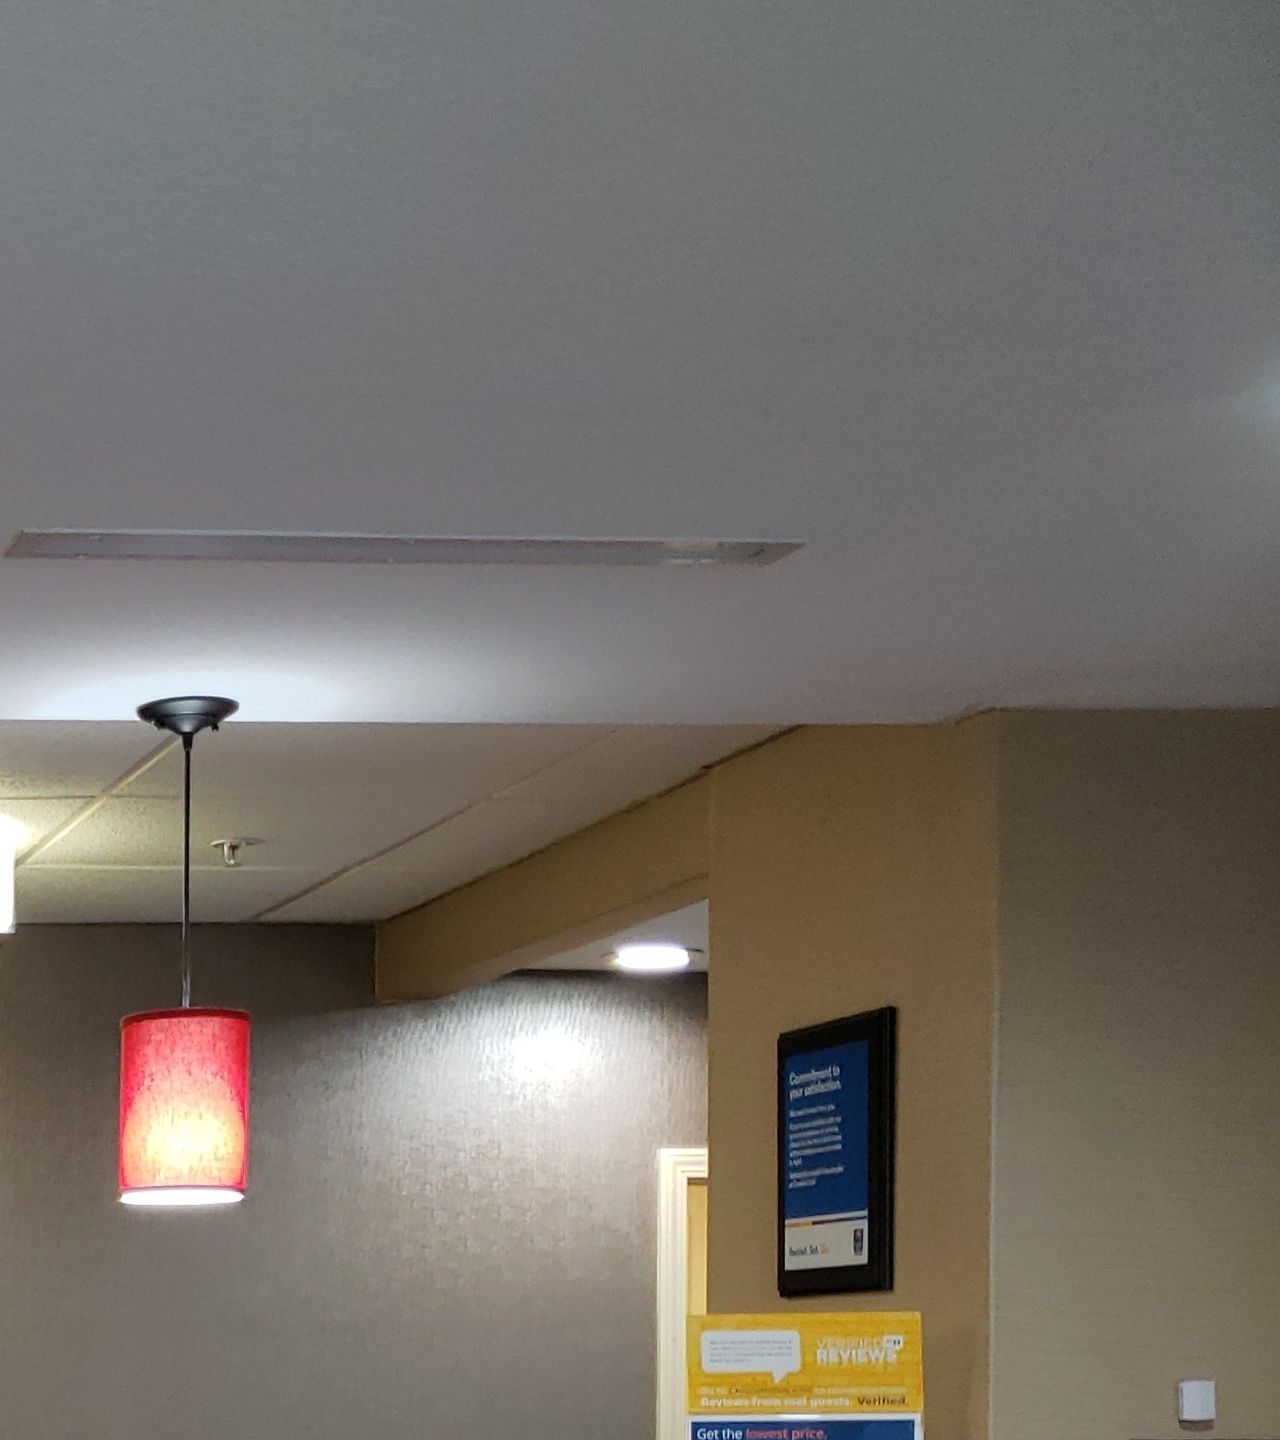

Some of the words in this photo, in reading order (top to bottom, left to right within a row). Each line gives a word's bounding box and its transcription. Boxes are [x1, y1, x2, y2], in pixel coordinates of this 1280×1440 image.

[816, 1349, 897, 1365] REVIEWS
[696, 1428, 720, 1440] Get
[721, 1428, 743, 1440] the
[746, 1428, 788, 1440] lowest
